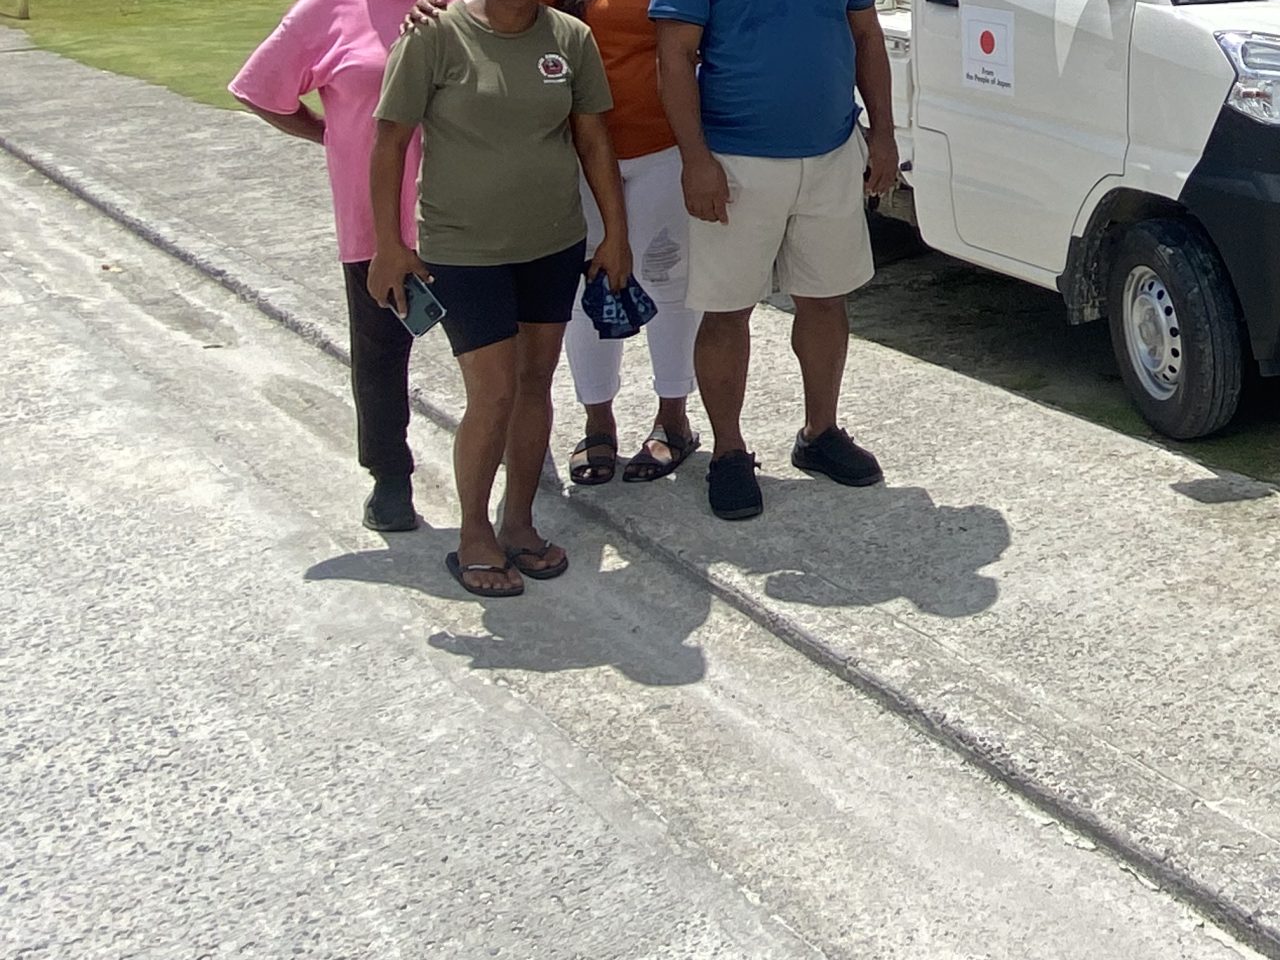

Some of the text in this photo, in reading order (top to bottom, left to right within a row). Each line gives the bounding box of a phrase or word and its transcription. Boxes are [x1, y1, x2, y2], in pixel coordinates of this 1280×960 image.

[981, 66, 994, 77] From
[966, 72, 1012, 89] the People of Japan
